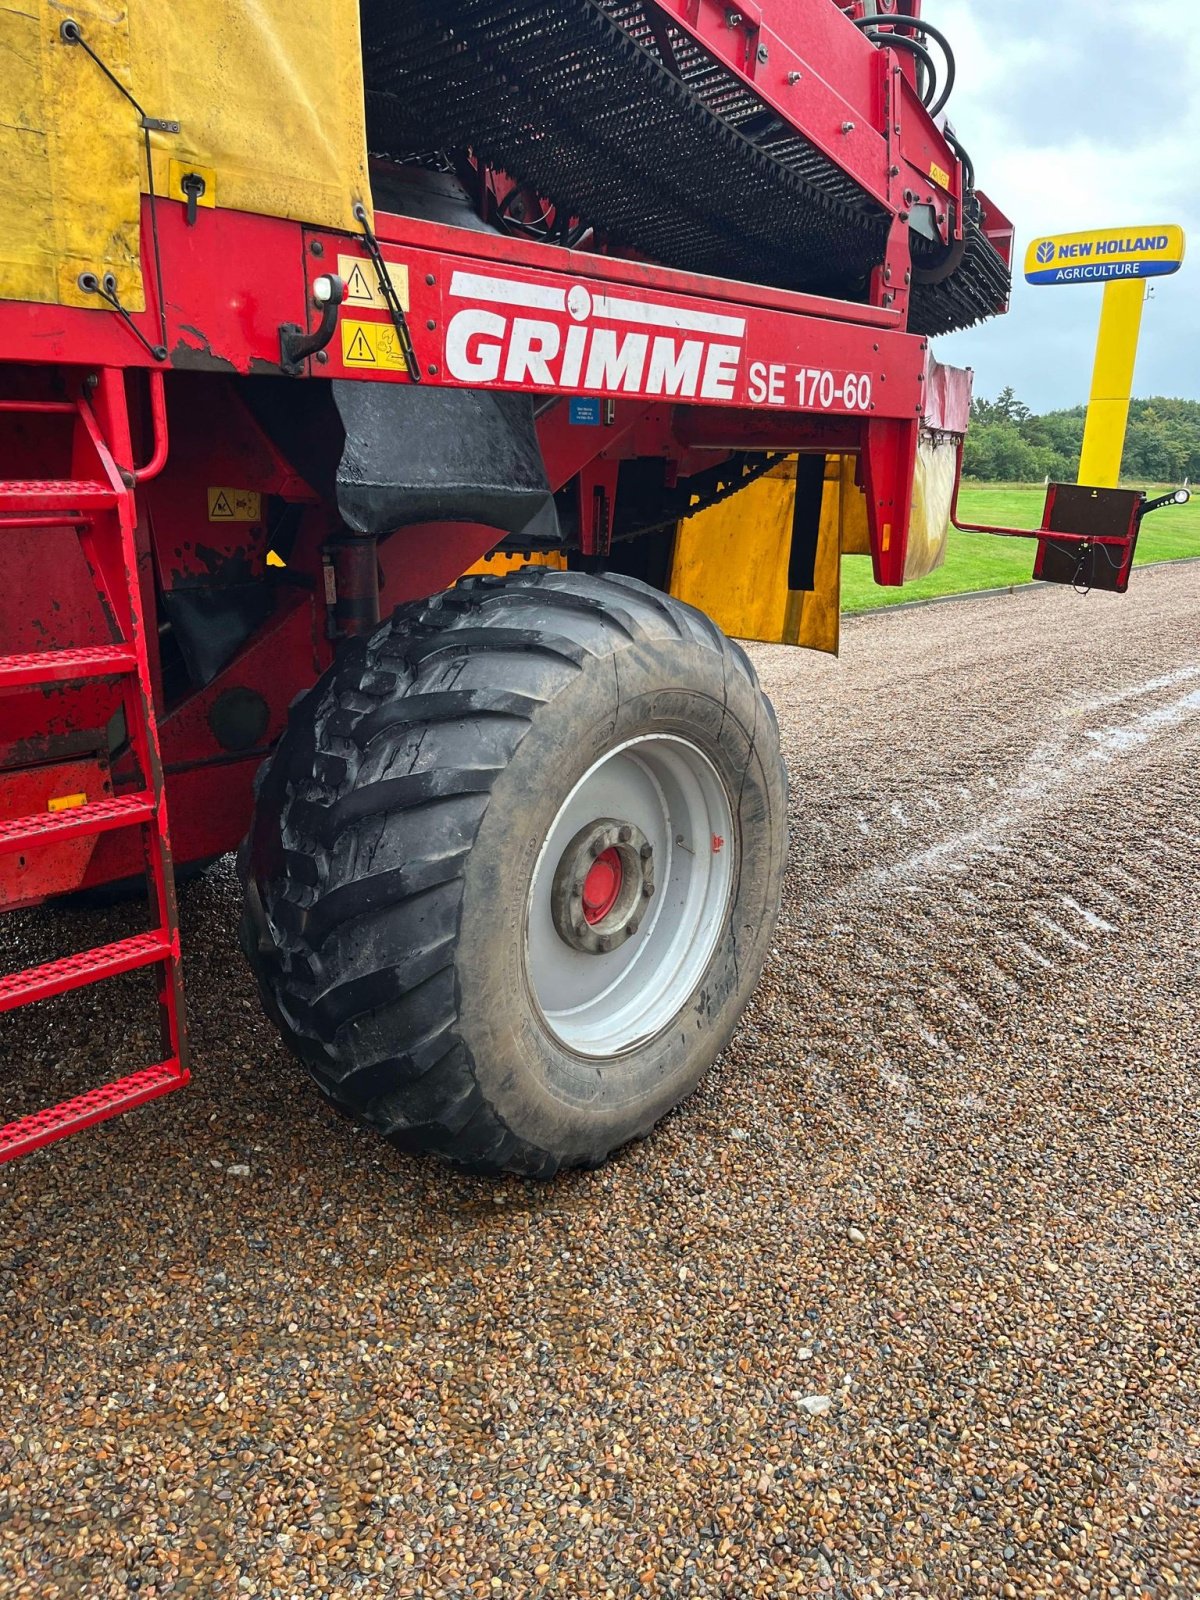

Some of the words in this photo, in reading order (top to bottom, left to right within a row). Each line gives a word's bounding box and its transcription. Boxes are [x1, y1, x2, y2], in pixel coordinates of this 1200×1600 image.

[1058, 241, 1093, 258] NEW
[1095, 235, 1168, 255] HOLLAND
[1056, 263, 1140, 280] AGRICULTURE
[445, 286, 742, 400] GRIMME
[748, 362, 786, 404] SE
[795, 368, 871, 410] 170-60
